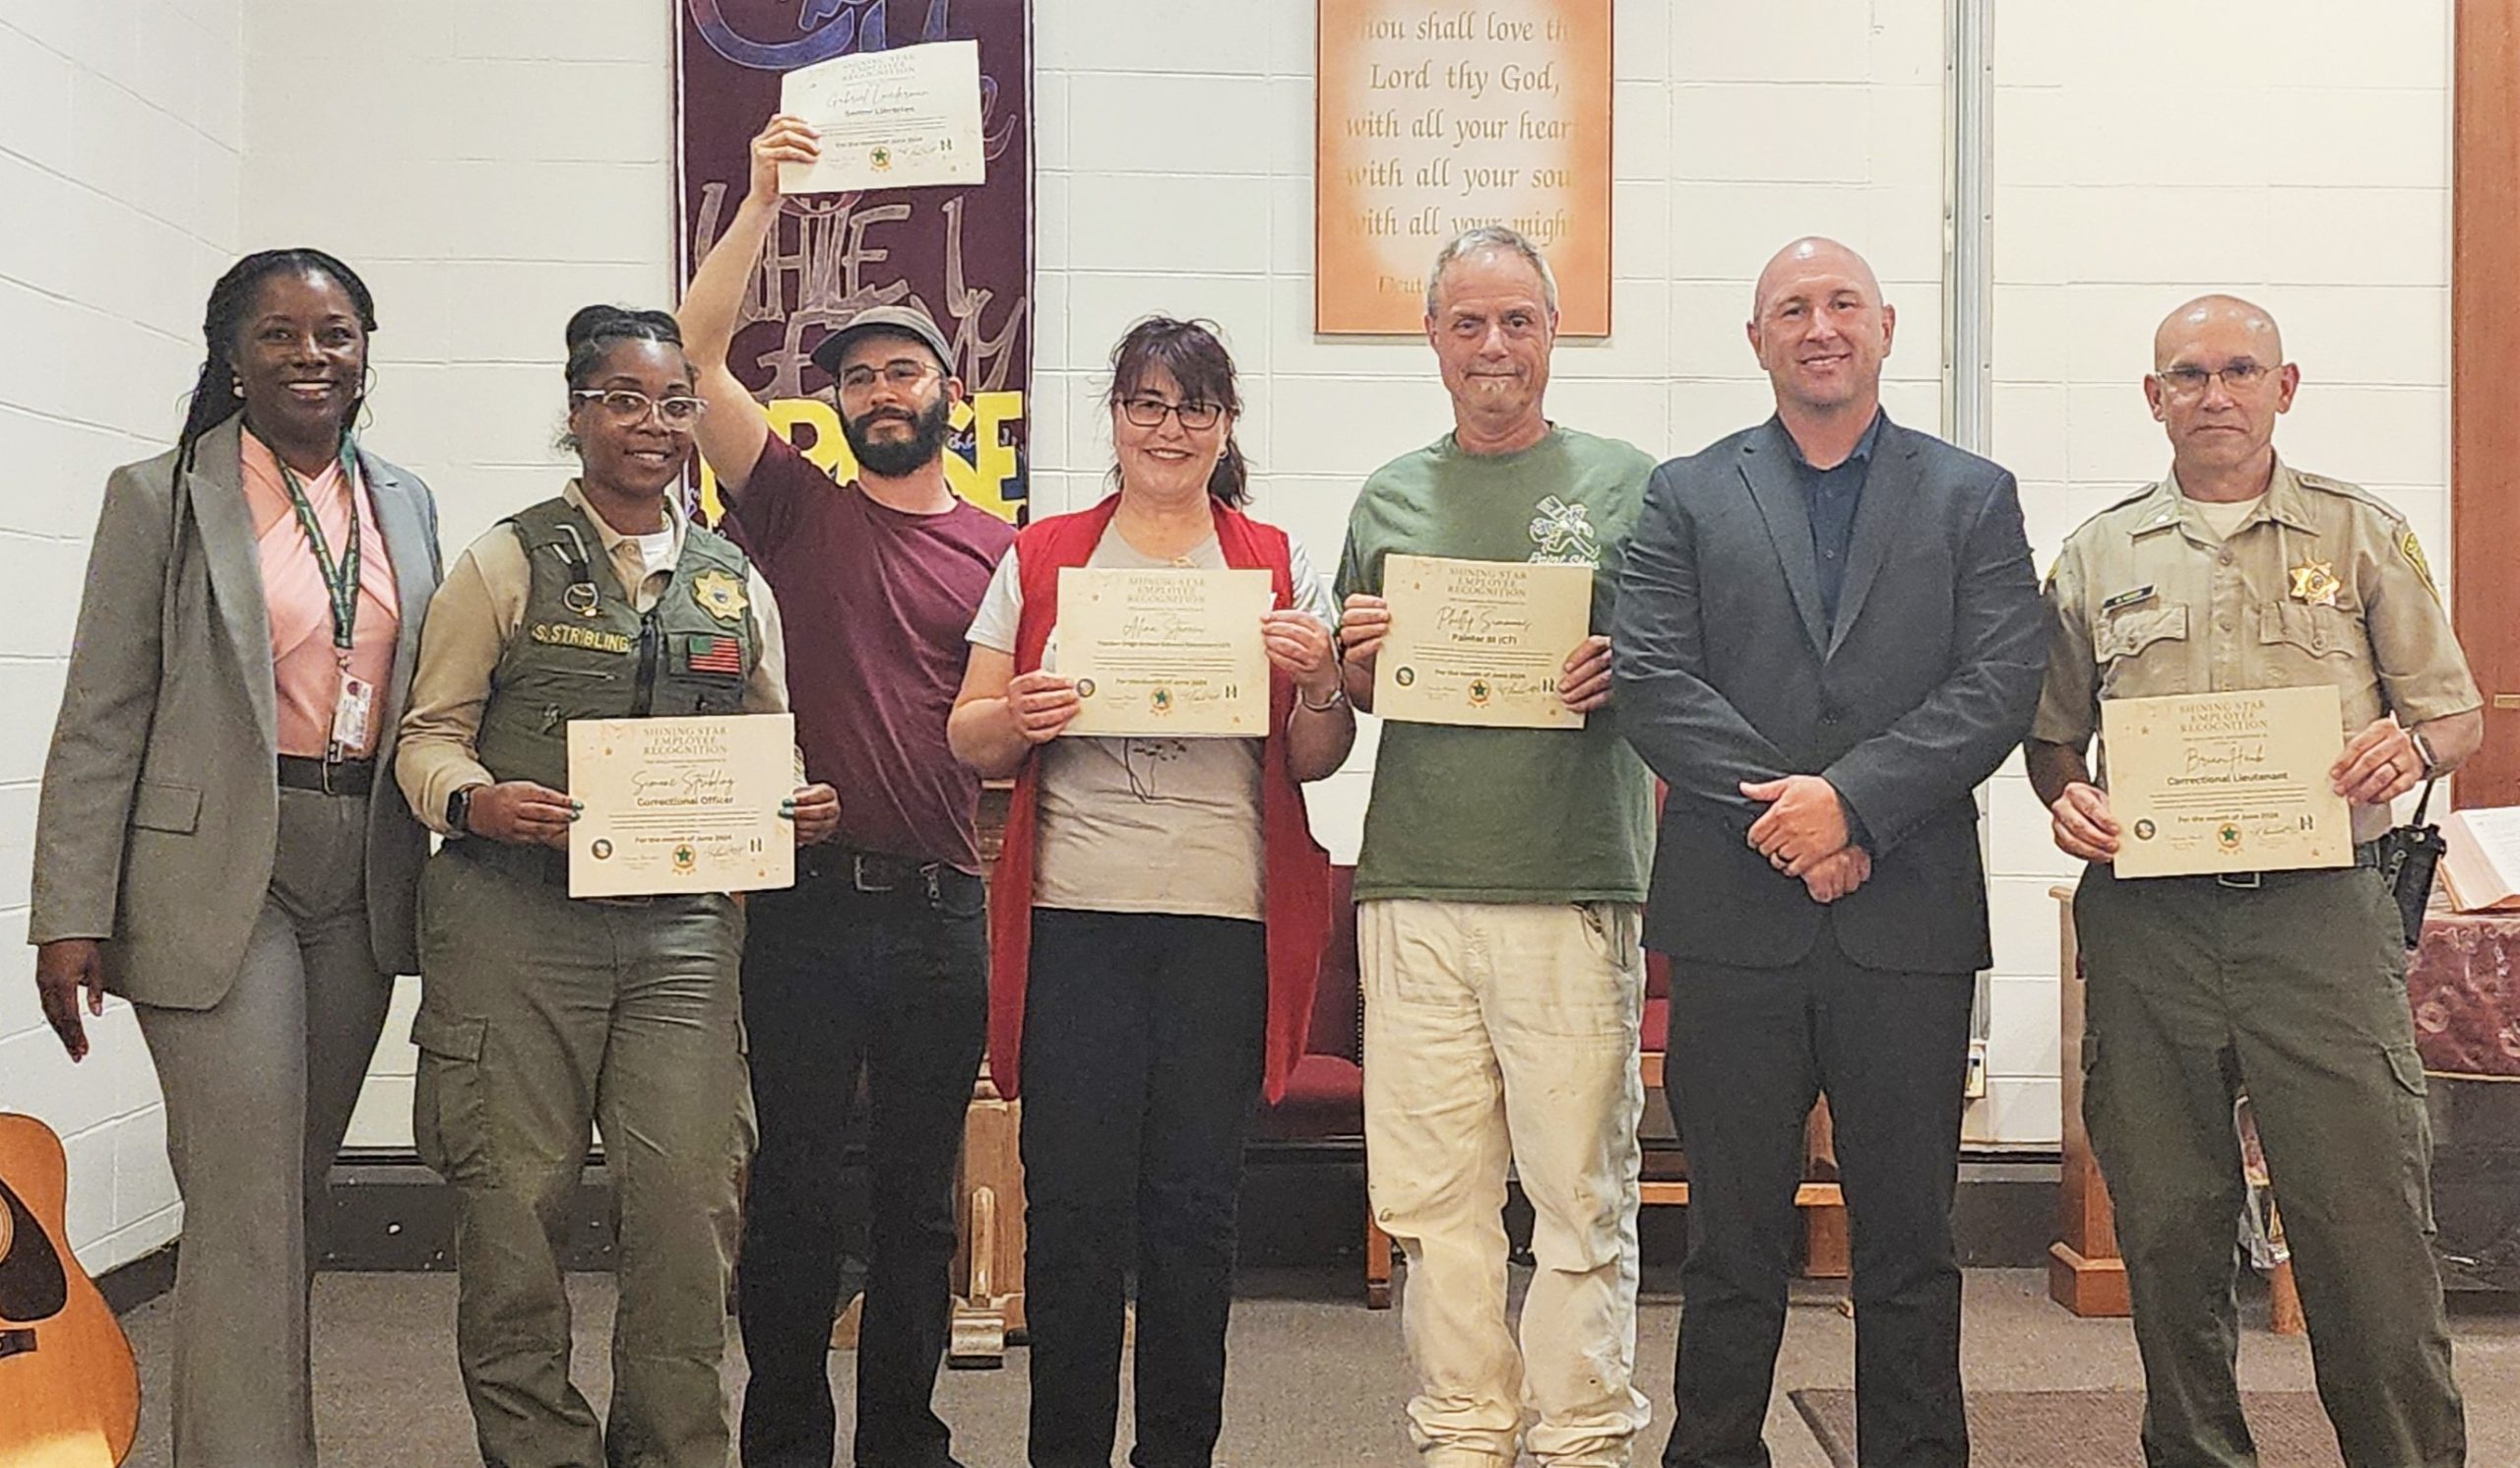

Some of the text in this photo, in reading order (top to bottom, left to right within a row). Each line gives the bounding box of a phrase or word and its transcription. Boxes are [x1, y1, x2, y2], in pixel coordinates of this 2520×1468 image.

[1360, 11, 1568, 41] hou shall love th
[1370, 59, 1560, 99] Lord thy God,
[1347, 107, 1572, 149] with all your hear
[1347, 158, 1572, 197] with all your sou
[1360, 206, 1398, 235] ith
[1409, 206, 1441, 235] all
[1513, 208, 1569, 247] migh
[2167, 771, 2288, 786] Correctional Lieutenant
[636, 796, 733, 806] Correctional Officer
